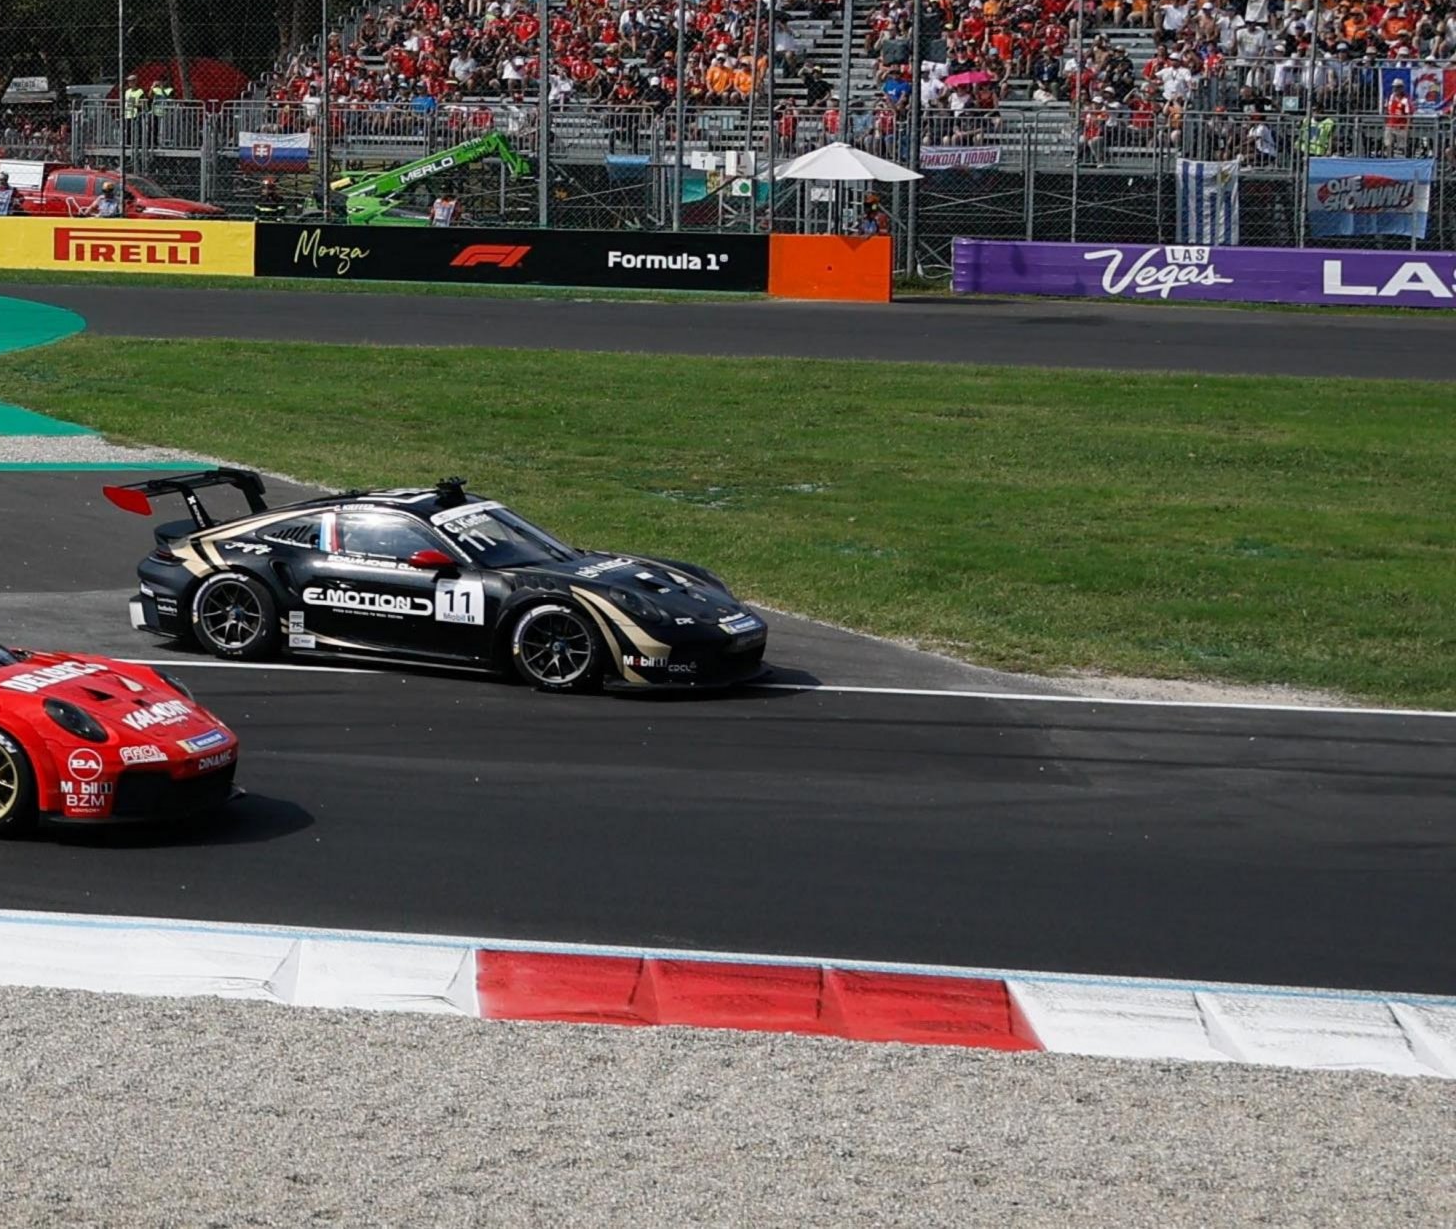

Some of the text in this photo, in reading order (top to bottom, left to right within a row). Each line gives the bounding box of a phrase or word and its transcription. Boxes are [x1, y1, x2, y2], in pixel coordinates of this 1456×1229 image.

[399, 156, 454, 184] MERLO
[53, 227, 202, 265] PIRELLI
[293, 228, 370, 275] Monza
[608, 251, 702, 270] Formula
[1083, 247, 1234, 299] LAS Vegas
[443, 522, 463, 533] C.
[457, 529, 497, 551] 11
[327, 555, 397, 569] SCHUMACHER
[444, 589, 472, 614] 11
[291, 621, 304, 629] 75
[443, 612, 466, 622] Mobil
[623, 655, 655, 667] Mobil
[66, 795, 105, 807] BZM
